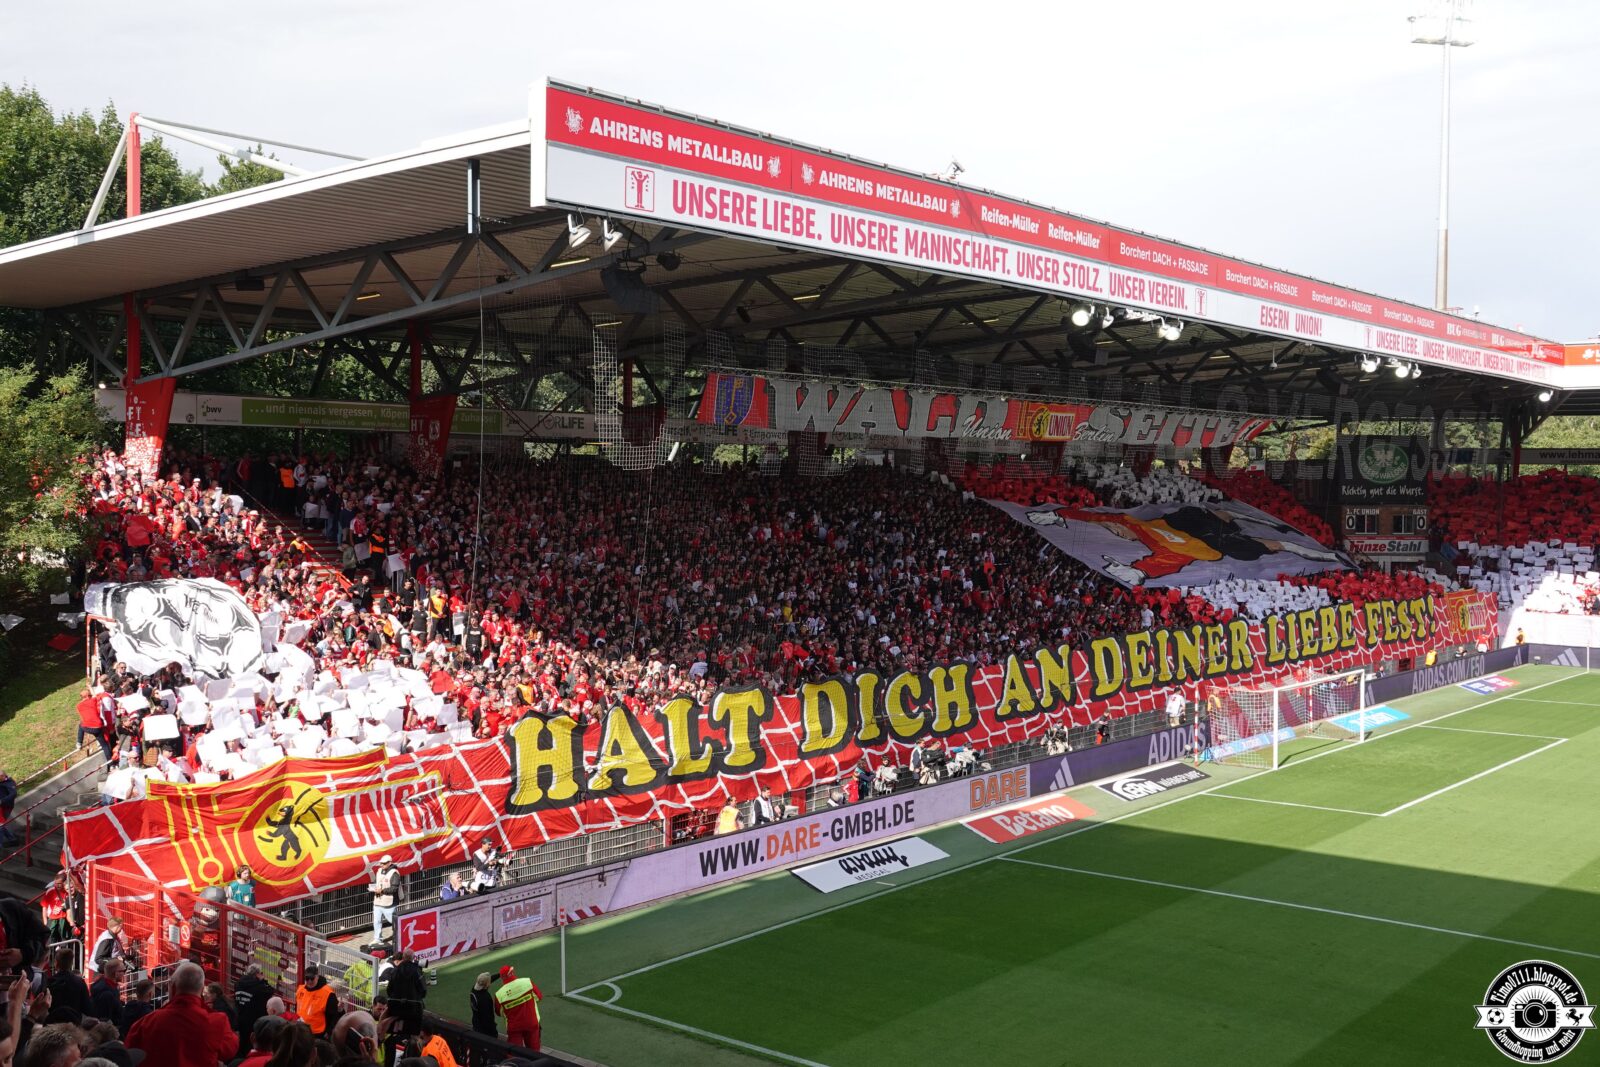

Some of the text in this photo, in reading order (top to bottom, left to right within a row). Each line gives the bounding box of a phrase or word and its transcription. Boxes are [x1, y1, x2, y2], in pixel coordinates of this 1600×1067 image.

[589, 117, 763, 171] AHRENS METALLBAU
[819, 170, 947, 214] AHRENS METALLBAU
[981, 205, 1040, 234] Reifen-Müller
[672, 179, 1188, 311] UNSERE LIEBE. UNSERE MANNSCHAFT. UNSER STOLZ. UNSER VEREIN.
[1048, 222, 1100, 249] Reifen-Müller
[1120, 242, 1151, 261] Borchert
[1152, 249, 1172, 266] DACH
[1178, 257, 1208, 276] FASSADE
[1225, 269, 1252, 287] Borchert
[1252, 276, 1269, 291] DACH
[1274, 281, 1299, 297] FASSADE
[1312, 290, 1333, 305] Borchert
[1333, 296, 1347, 309] DACH
[1351, 300, 1373, 315] FASSADE
[1260, 305, 1323, 337] EISERN UNION!
[1376, 330, 1401, 351] UNSERE
[1401, 336, 1420, 355] LIEBE.
[1423, 341, 1445, 360] UNSERE
[1446, 346, 1482, 366] MANNSCHAFT.
[1483, 353, 1500, 369] UNSER
[206, 405, 222, 414] bwv
[288, 404, 326, 415] niemals
[328, 407, 377, 420] vergessen,
[1049, 413, 1074, 436] UNION
[961, 415, 1012, 440] Union
[1074, 421, 1116, 443] Berlin
[1341, 485, 1424, 497] Richtig gut die Wurst.
[1347, 516, 1354, 529] 0
[1418, 516, 1425, 529] 0
[1412, 654, 1485, 694] ADIDAS.COM/F50
[508, 595, 1435, 812] HALT DICH AN DEINER LIEBE FEST!
[1148, 723, 1206, 765] ADIDAS
[970, 768, 1028, 811] DARE
[331, 777, 445, 849] UNION
[993, 804, 1075, 837] Betano
[700, 800, 915, 877] WWW.DARE-GMBH.DE
[855, 868, 891, 881] MEDICAL
